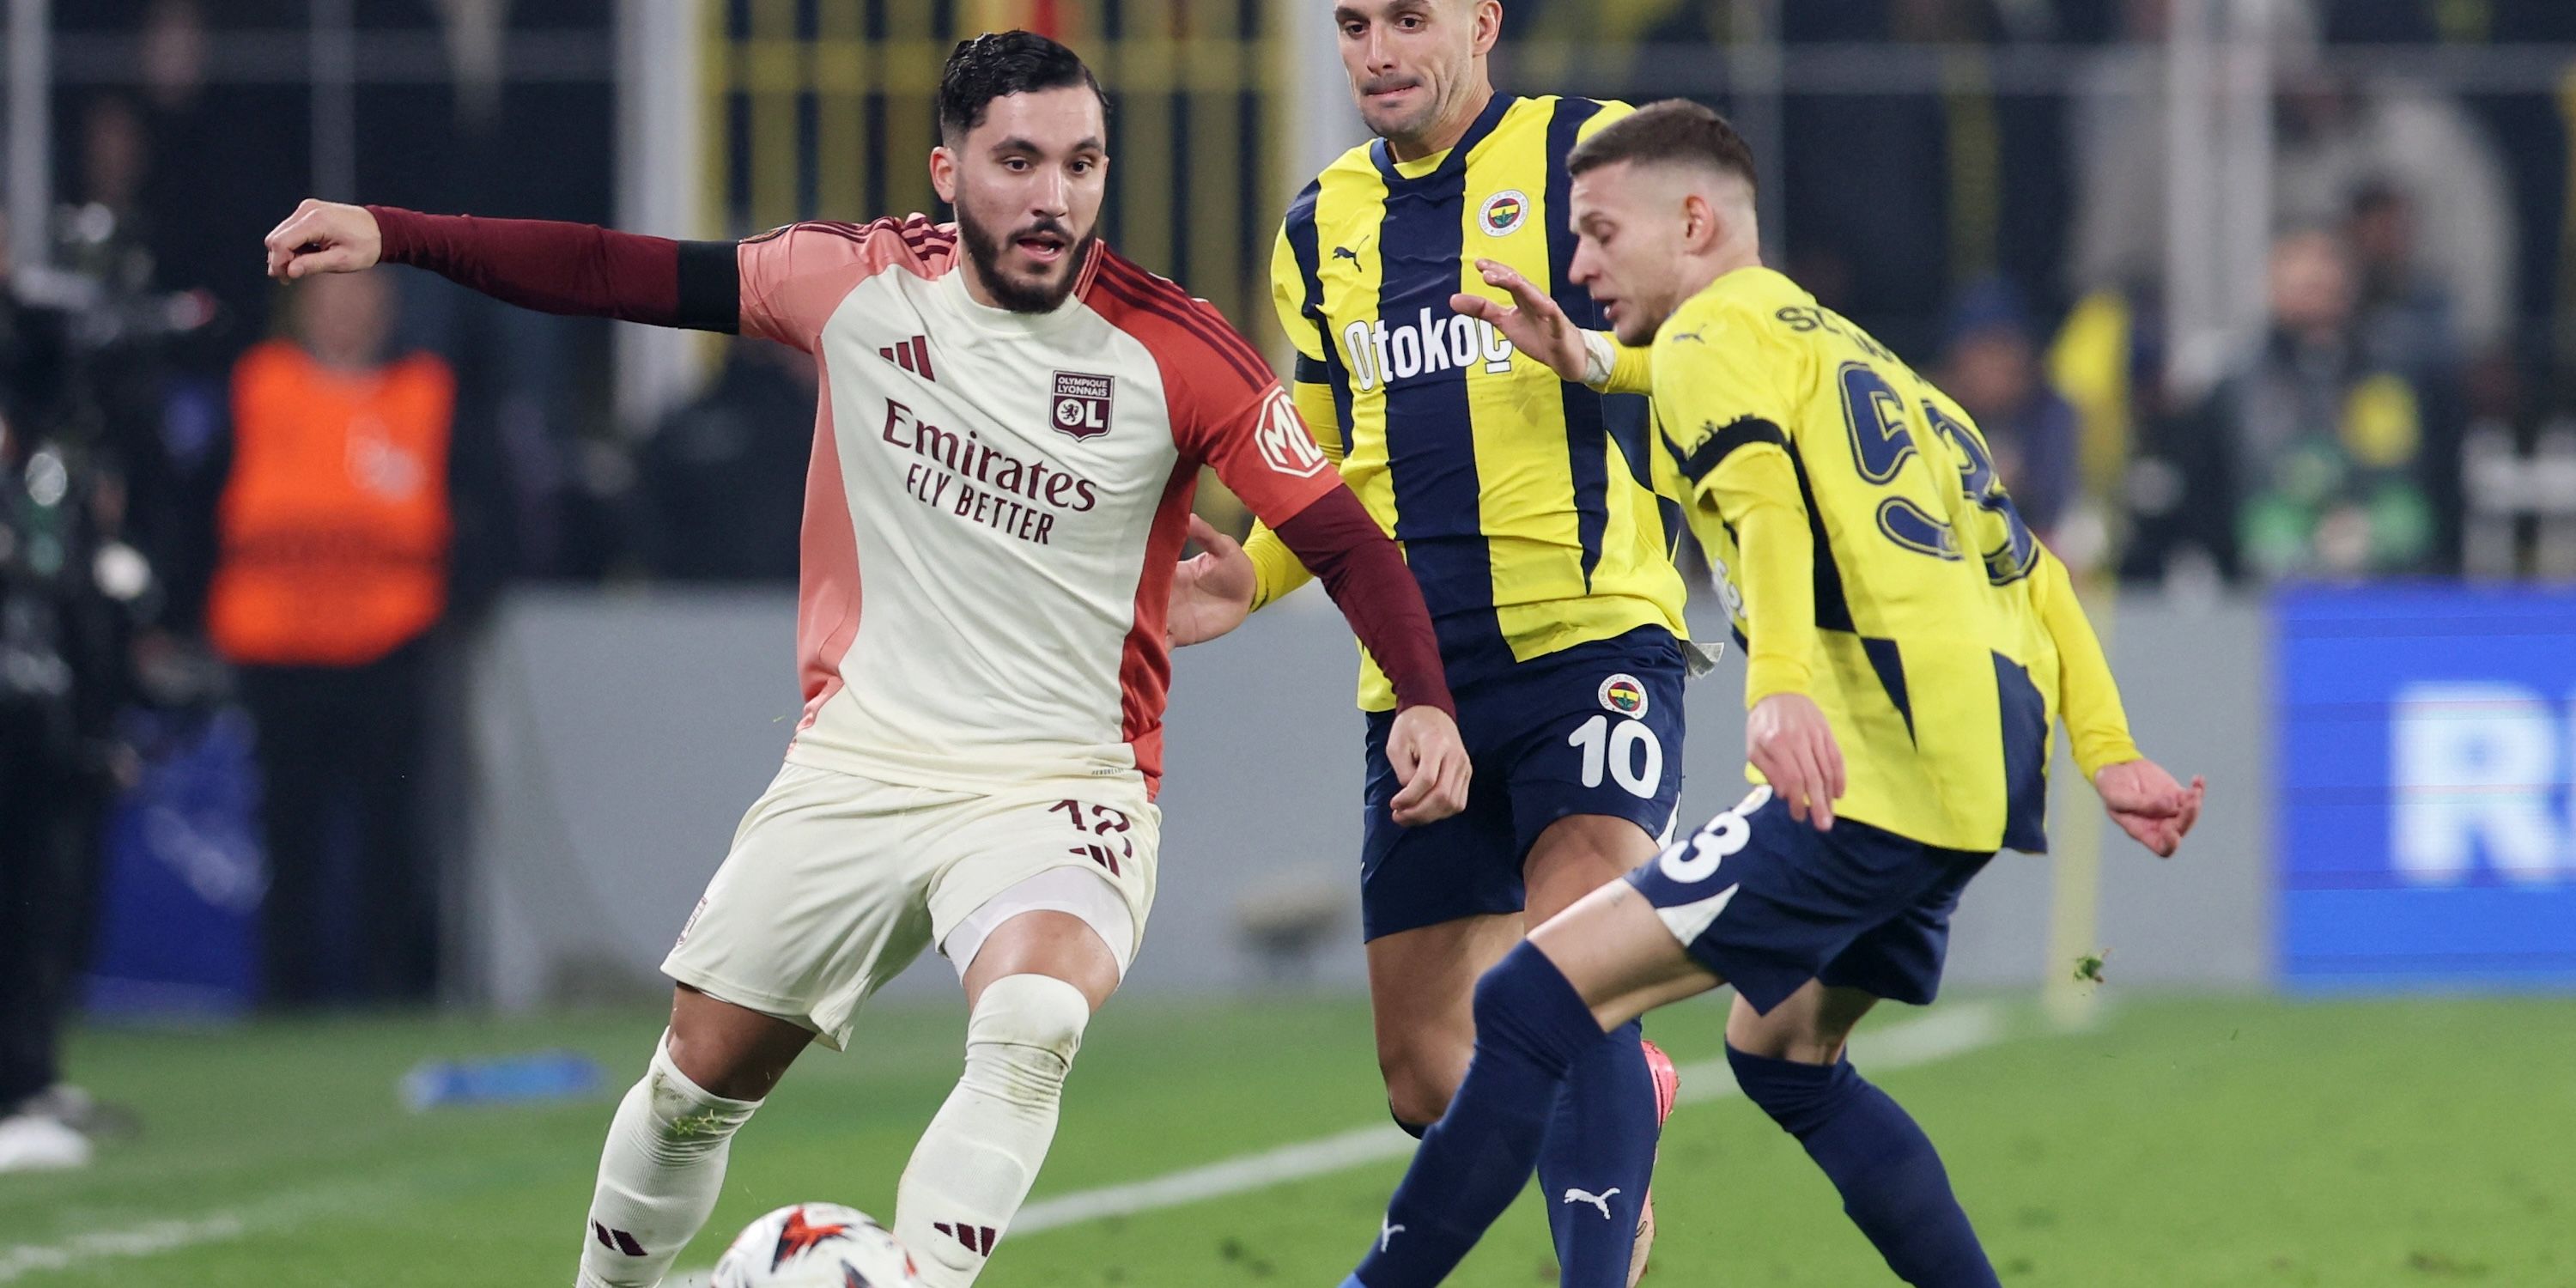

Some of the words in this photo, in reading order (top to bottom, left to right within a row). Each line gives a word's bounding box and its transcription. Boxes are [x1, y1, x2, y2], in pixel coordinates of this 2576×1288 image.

[1057, 376, 1108, 388] OLYMPIQUE
[1344, 307, 1514, 391] Otokoç
[1057, 385, 1108, 397] LYONNAIS
[883, 397, 1097, 513] Emirates
[907, 463, 951, 507] FLY
[954, 484, 1054, 545] BETTER
[1568, 714, 1662, 799] 10
